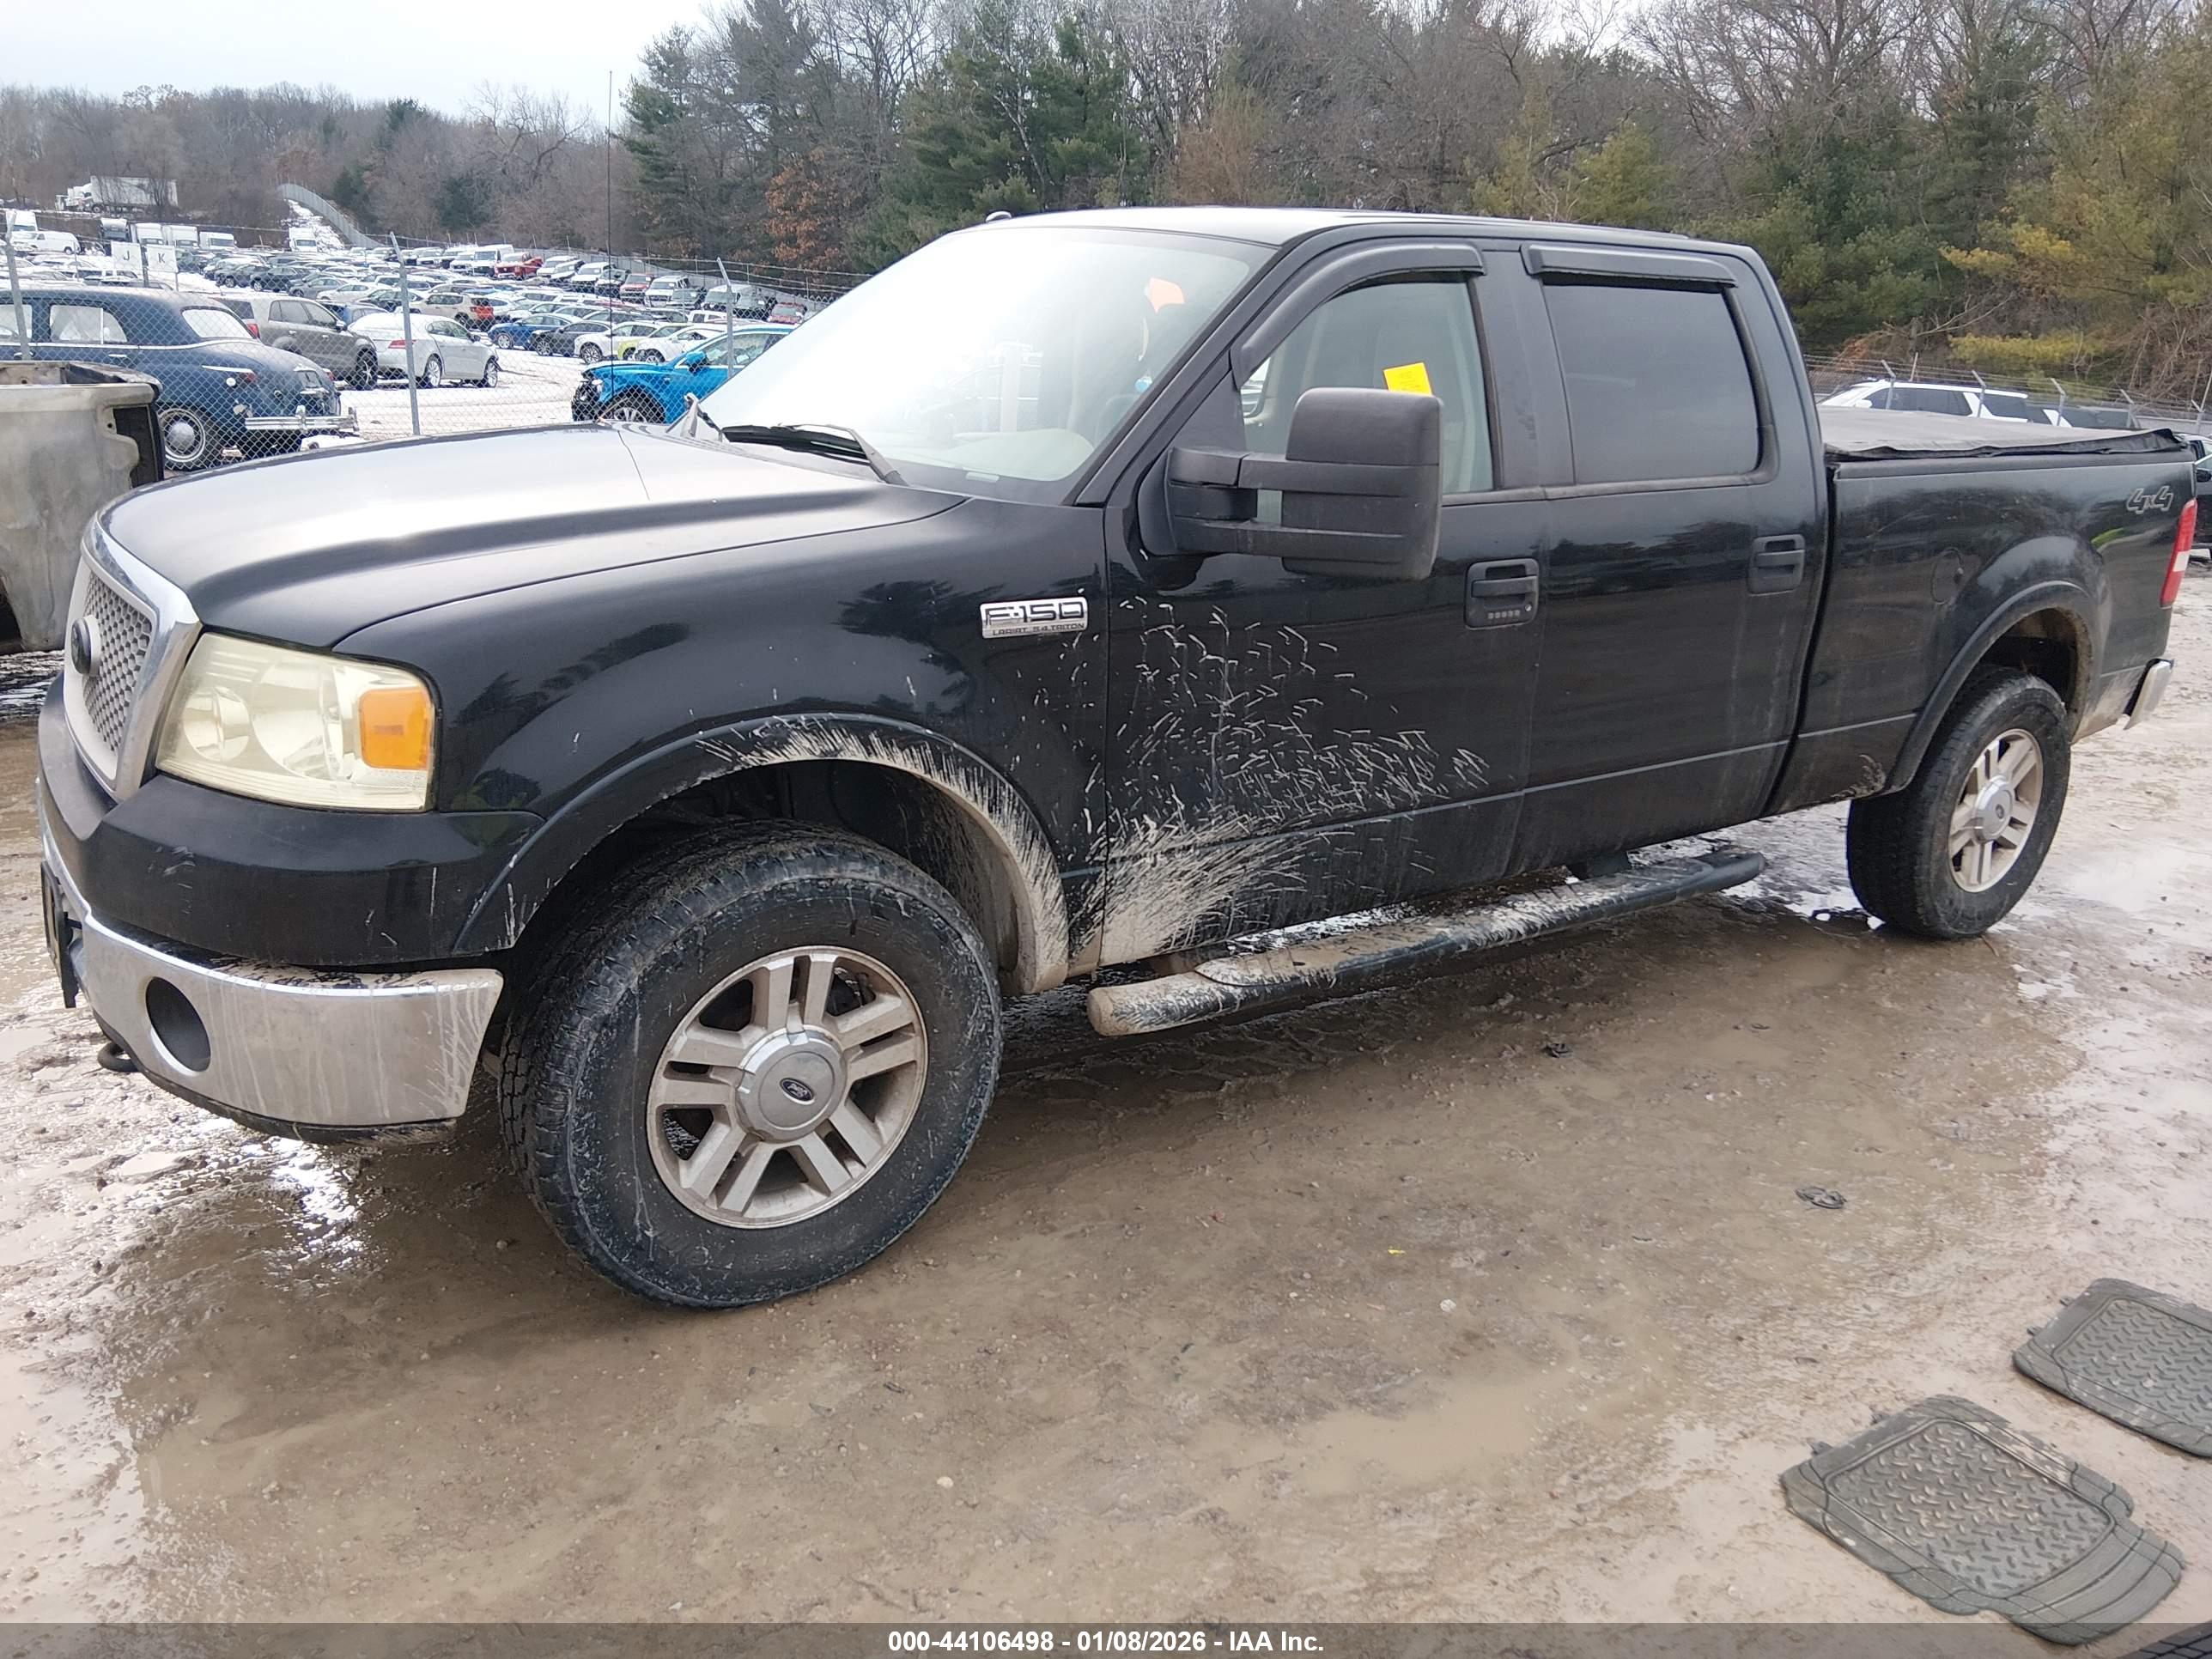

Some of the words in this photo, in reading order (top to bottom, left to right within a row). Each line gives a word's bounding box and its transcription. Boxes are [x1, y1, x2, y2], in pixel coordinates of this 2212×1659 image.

[123, 250, 131, 261] J
[157, 252, 166, 264] K
[2126, 485, 2173, 514] 4x4
[985, 601, 1085, 626] F-150
[992, 628, 1028, 636] LARIAT
[1049, 623, 1085, 631] TRITON
